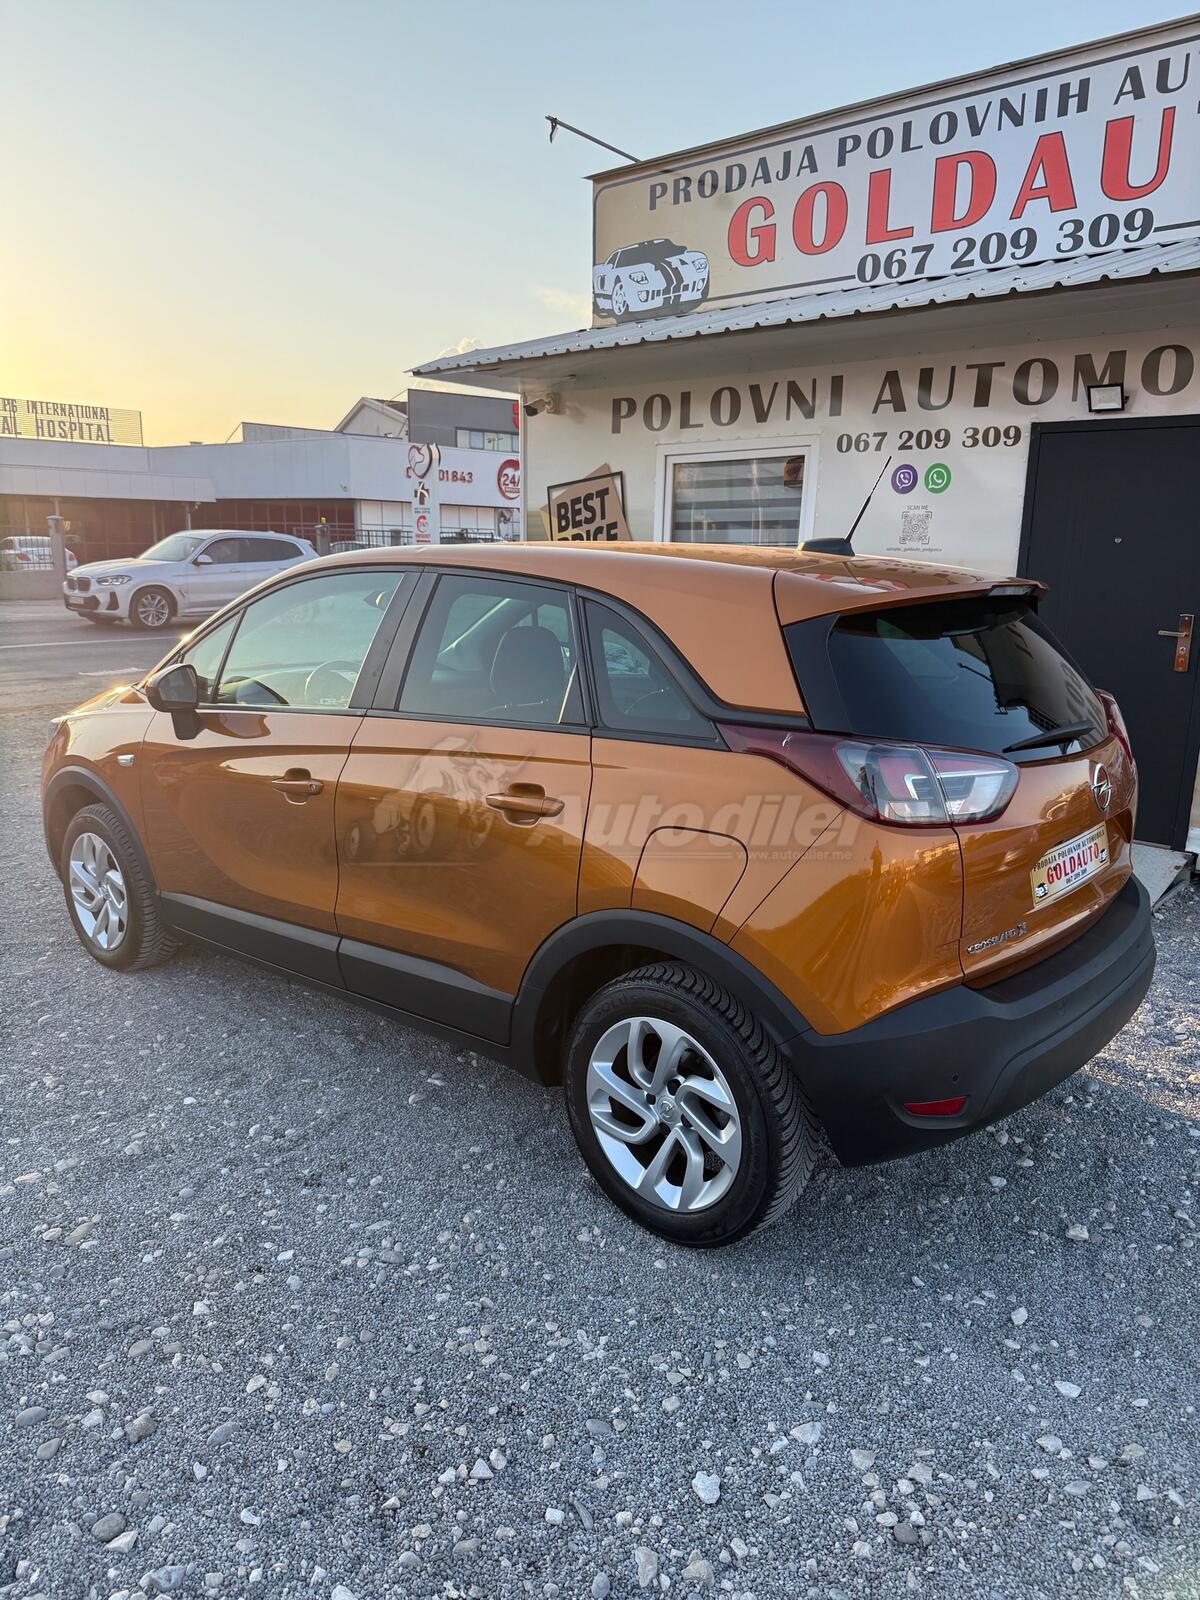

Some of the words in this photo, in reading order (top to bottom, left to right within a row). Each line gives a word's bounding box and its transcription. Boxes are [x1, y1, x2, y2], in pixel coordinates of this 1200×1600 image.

[649, 145, 819, 210] PRODAJA
[837, 77, 1090, 167] POLOVNIH
[1113, 50, 1200, 105] AU
[727, 101, 1200, 267] GOLDAU
[856, 243, 933, 283] 067
[951, 226, 1038, 268] 209
[1056, 208, 1154, 253] 309
[27, 400, 111, 420] INTERNATIONAL
[611, 374, 844, 434] POLOVNI
[872, 344, 1195, 415] AUTOMO
[36, 419, 114, 442] HOSPITAL
[836, 431, 888, 454] 067
[898, 428, 951, 451] 209
[961, 425, 1022, 448] 309
[556, 487, 609, 534] BEST
[1047, 842, 1100, 884] GOLDAUTO
